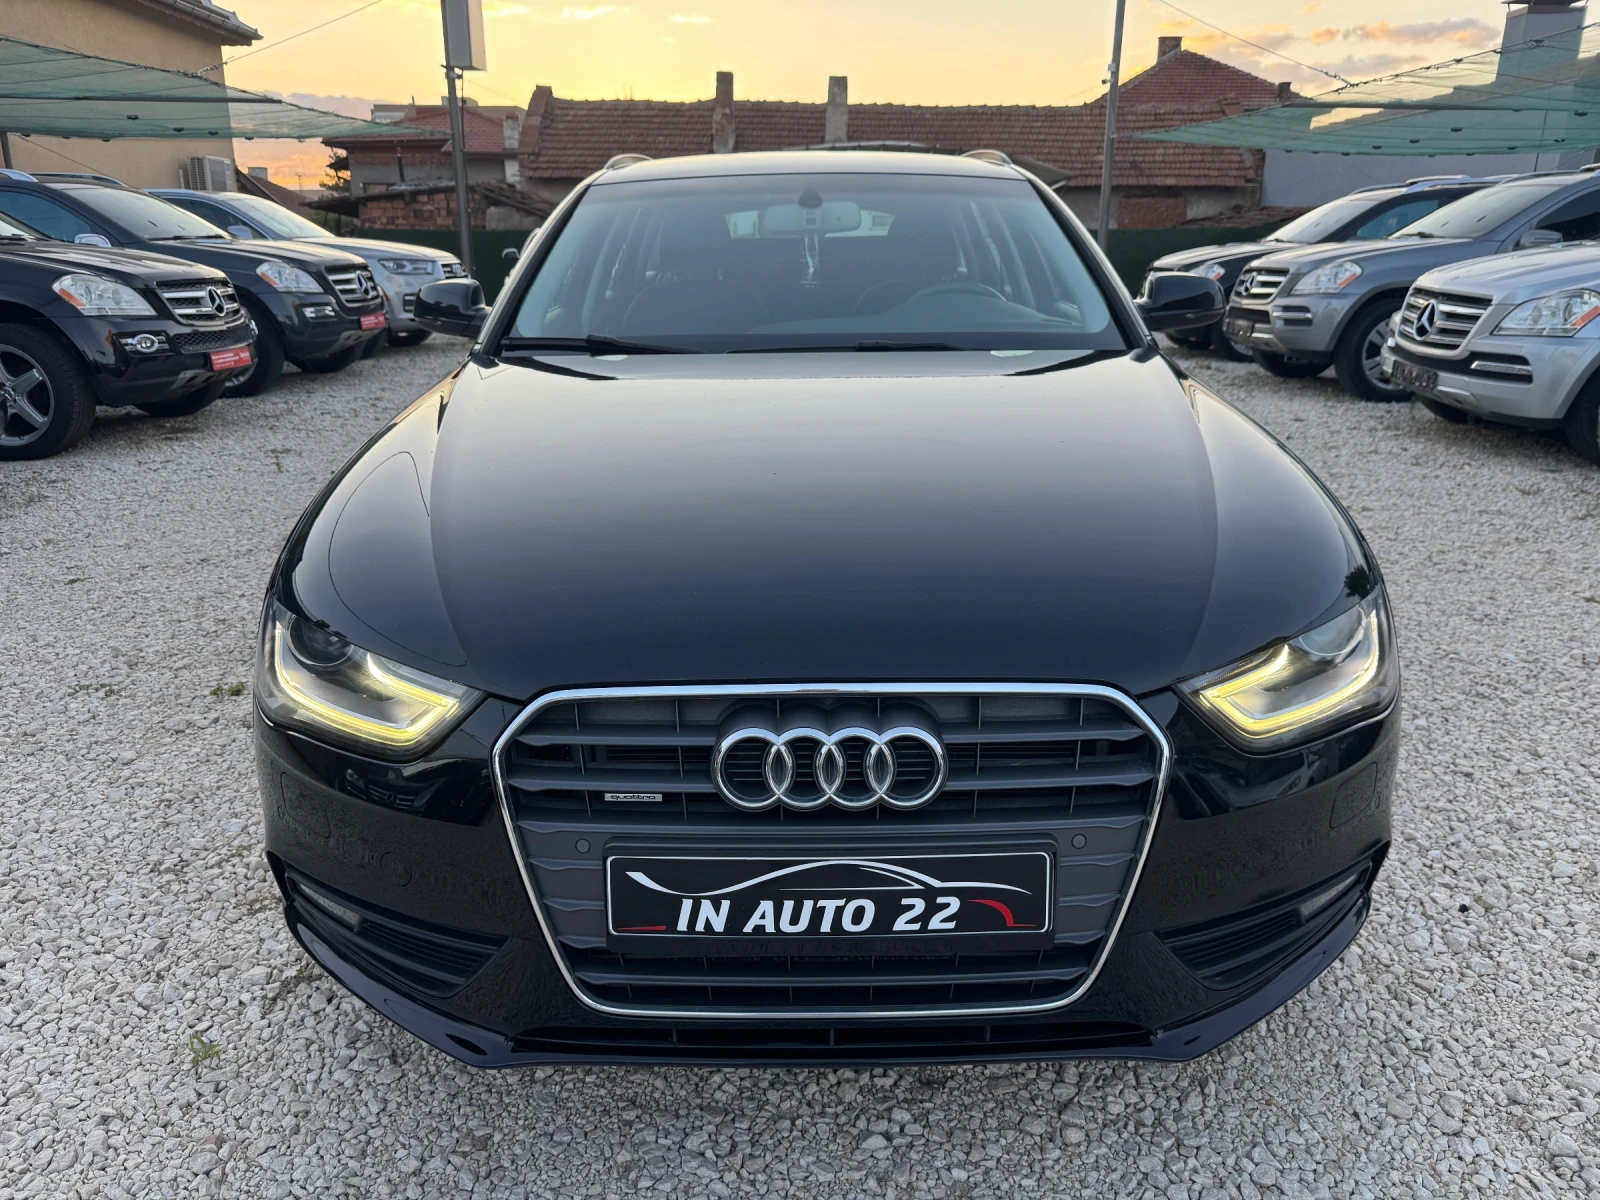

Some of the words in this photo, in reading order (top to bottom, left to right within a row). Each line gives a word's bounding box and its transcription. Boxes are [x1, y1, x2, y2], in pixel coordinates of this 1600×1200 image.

[676, 898, 730, 932] IN
[743, 897, 875, 933] AUTO
[892, 896, 961, 931] 22
